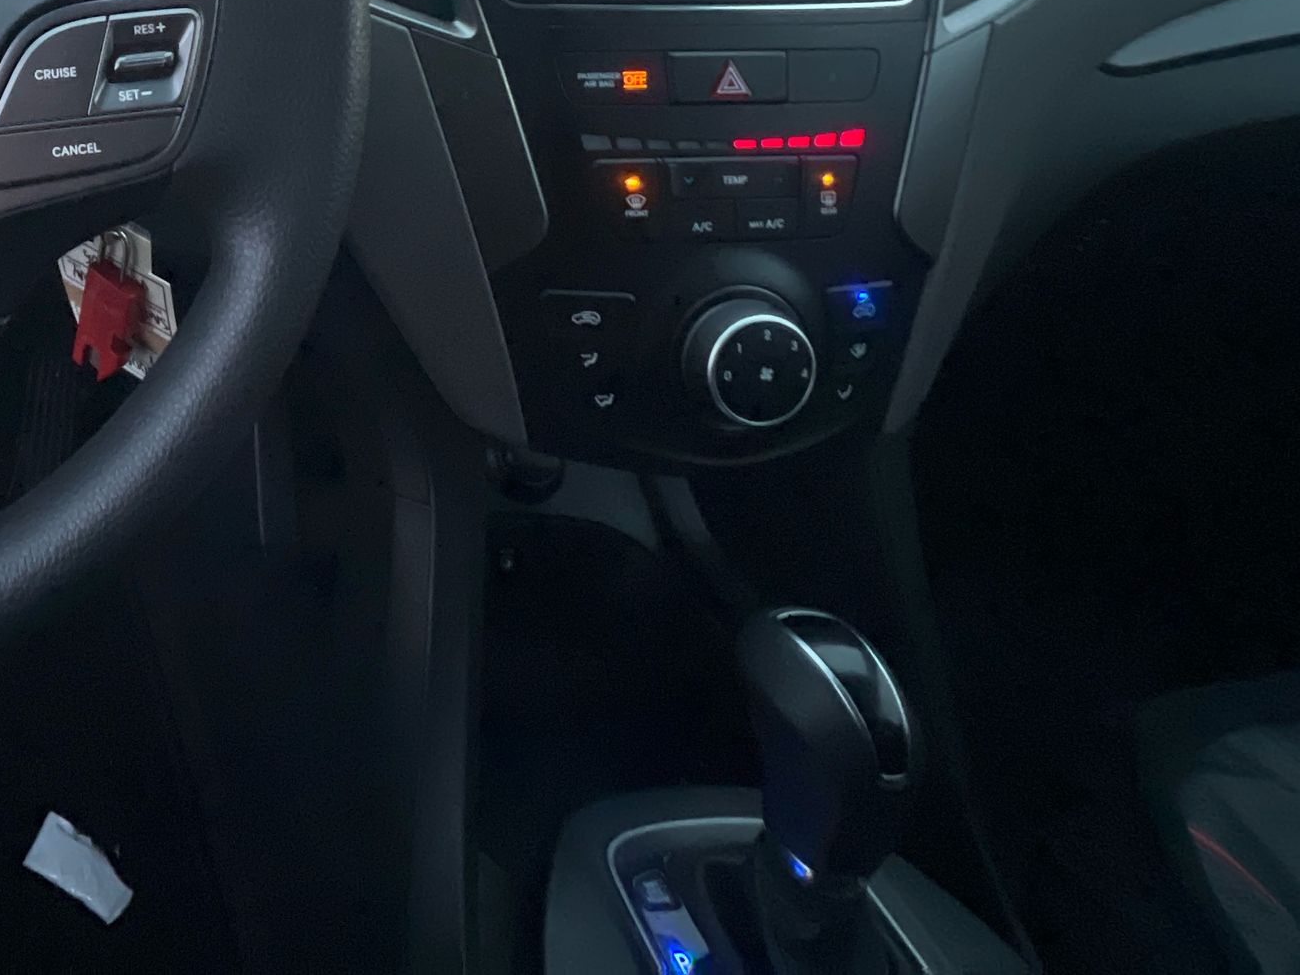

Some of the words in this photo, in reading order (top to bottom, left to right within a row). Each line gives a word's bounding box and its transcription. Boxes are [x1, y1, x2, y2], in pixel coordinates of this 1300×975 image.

[34, 66, 77, 81] CRUISE
[624, 74, 647, 86] OFF
[52, 142, 101, 158] CANCEL
[722, 174, 749, 186] TEMP
[691, 221, 714, 233] A/C
[765, 218, 786, 230] A/C
[763, 329, 772, 341] 2
